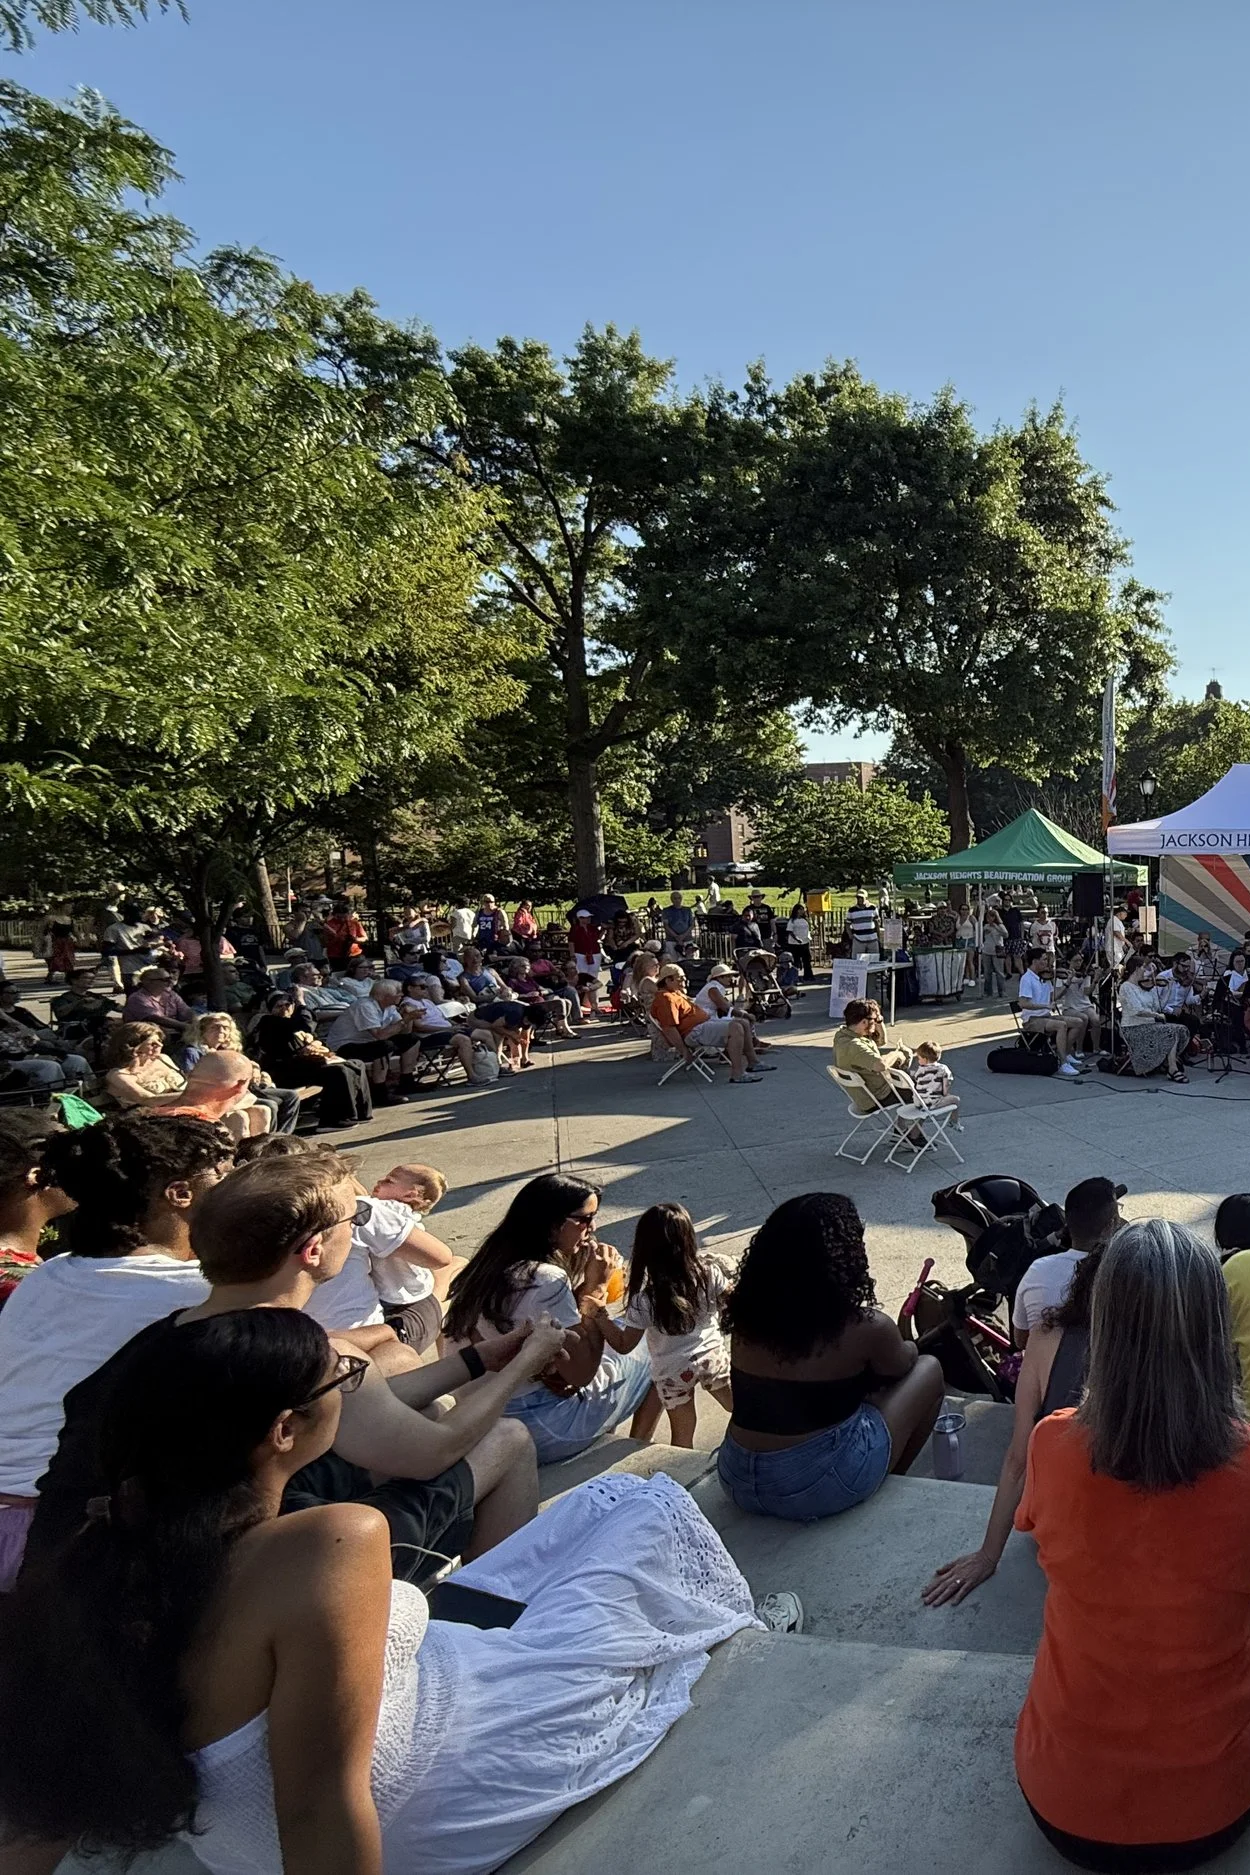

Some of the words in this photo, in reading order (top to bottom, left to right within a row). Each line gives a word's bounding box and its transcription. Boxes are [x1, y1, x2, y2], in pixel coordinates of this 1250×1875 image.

[1160, 833, 1233, 849] JACKSON
[914, 872, 948, 881] JACKSON
[950, 871, 982, 880] HEIGHTS
[984, 871, 1045, 882] BEAUTIFICATION
[1047, 874, 1072, 883] GROUP
[480, 921, 492, 930] 24
